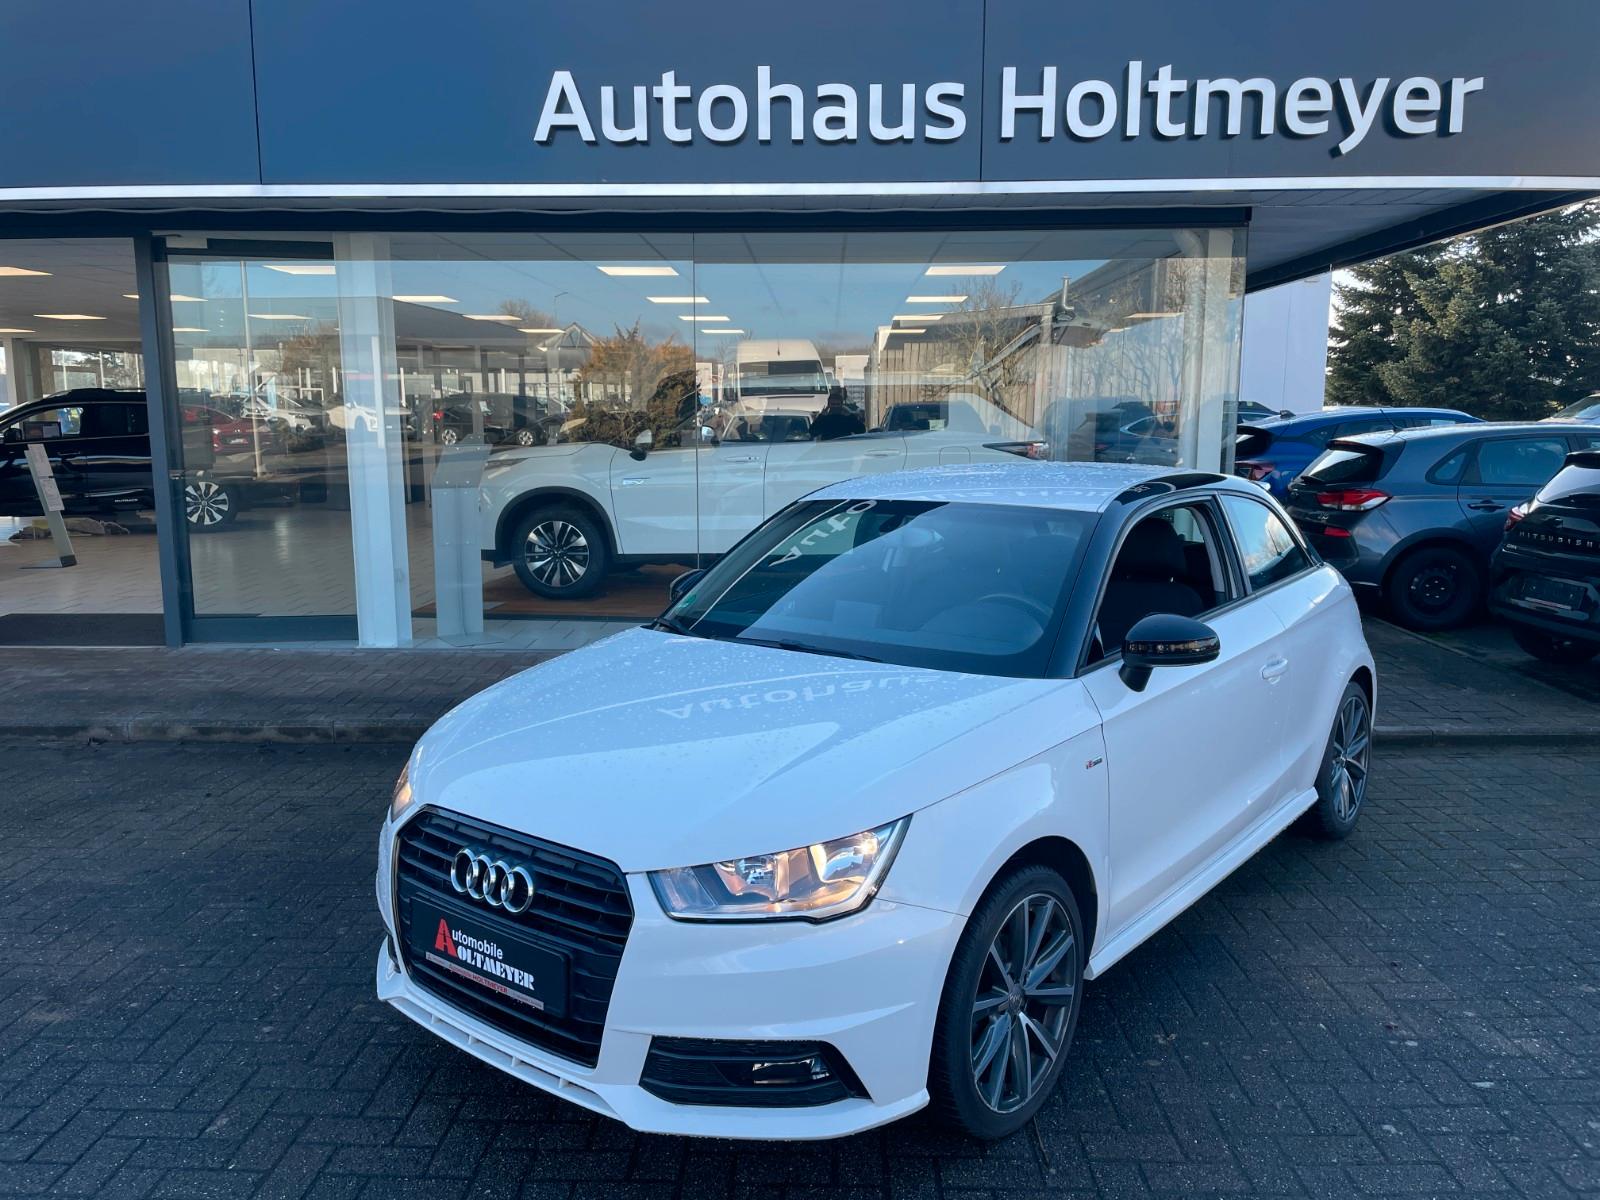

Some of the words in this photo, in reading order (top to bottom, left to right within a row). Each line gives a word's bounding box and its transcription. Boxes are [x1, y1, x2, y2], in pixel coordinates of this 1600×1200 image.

[533, 65, 967, 142] Autohaus
[1000, 60, 1485, 155] Holtmeyer
[1519, 530, 1600, 549] MITSUBISH
